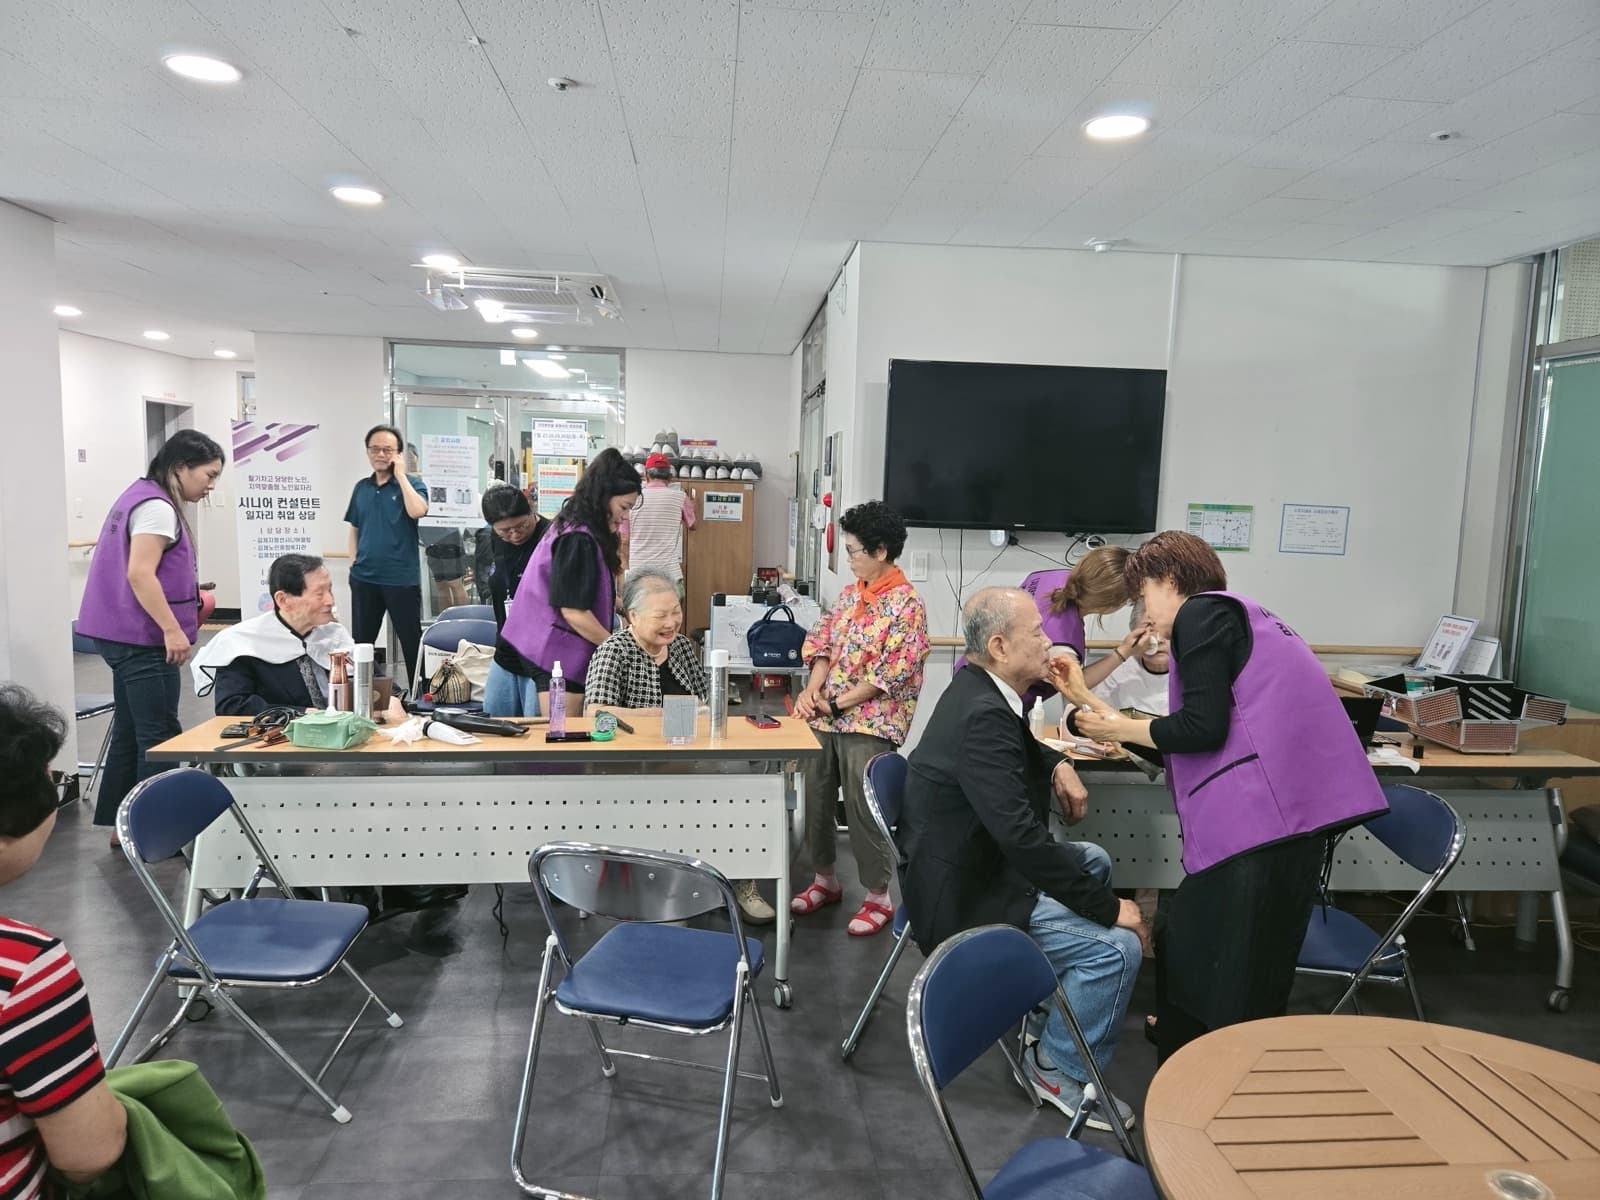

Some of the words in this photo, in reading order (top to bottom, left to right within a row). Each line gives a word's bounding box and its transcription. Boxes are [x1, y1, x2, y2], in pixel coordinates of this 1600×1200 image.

[249, 483, 280, 491] 지역맞춤형
[238, 497, 273, 508] 시니어
[277, 497, 320, 509] 컨설턴트
[245, 510, 273, 520] 일자리
[277, 510, 295, 520] 취업
[298, 510, 316, 520] 상담
